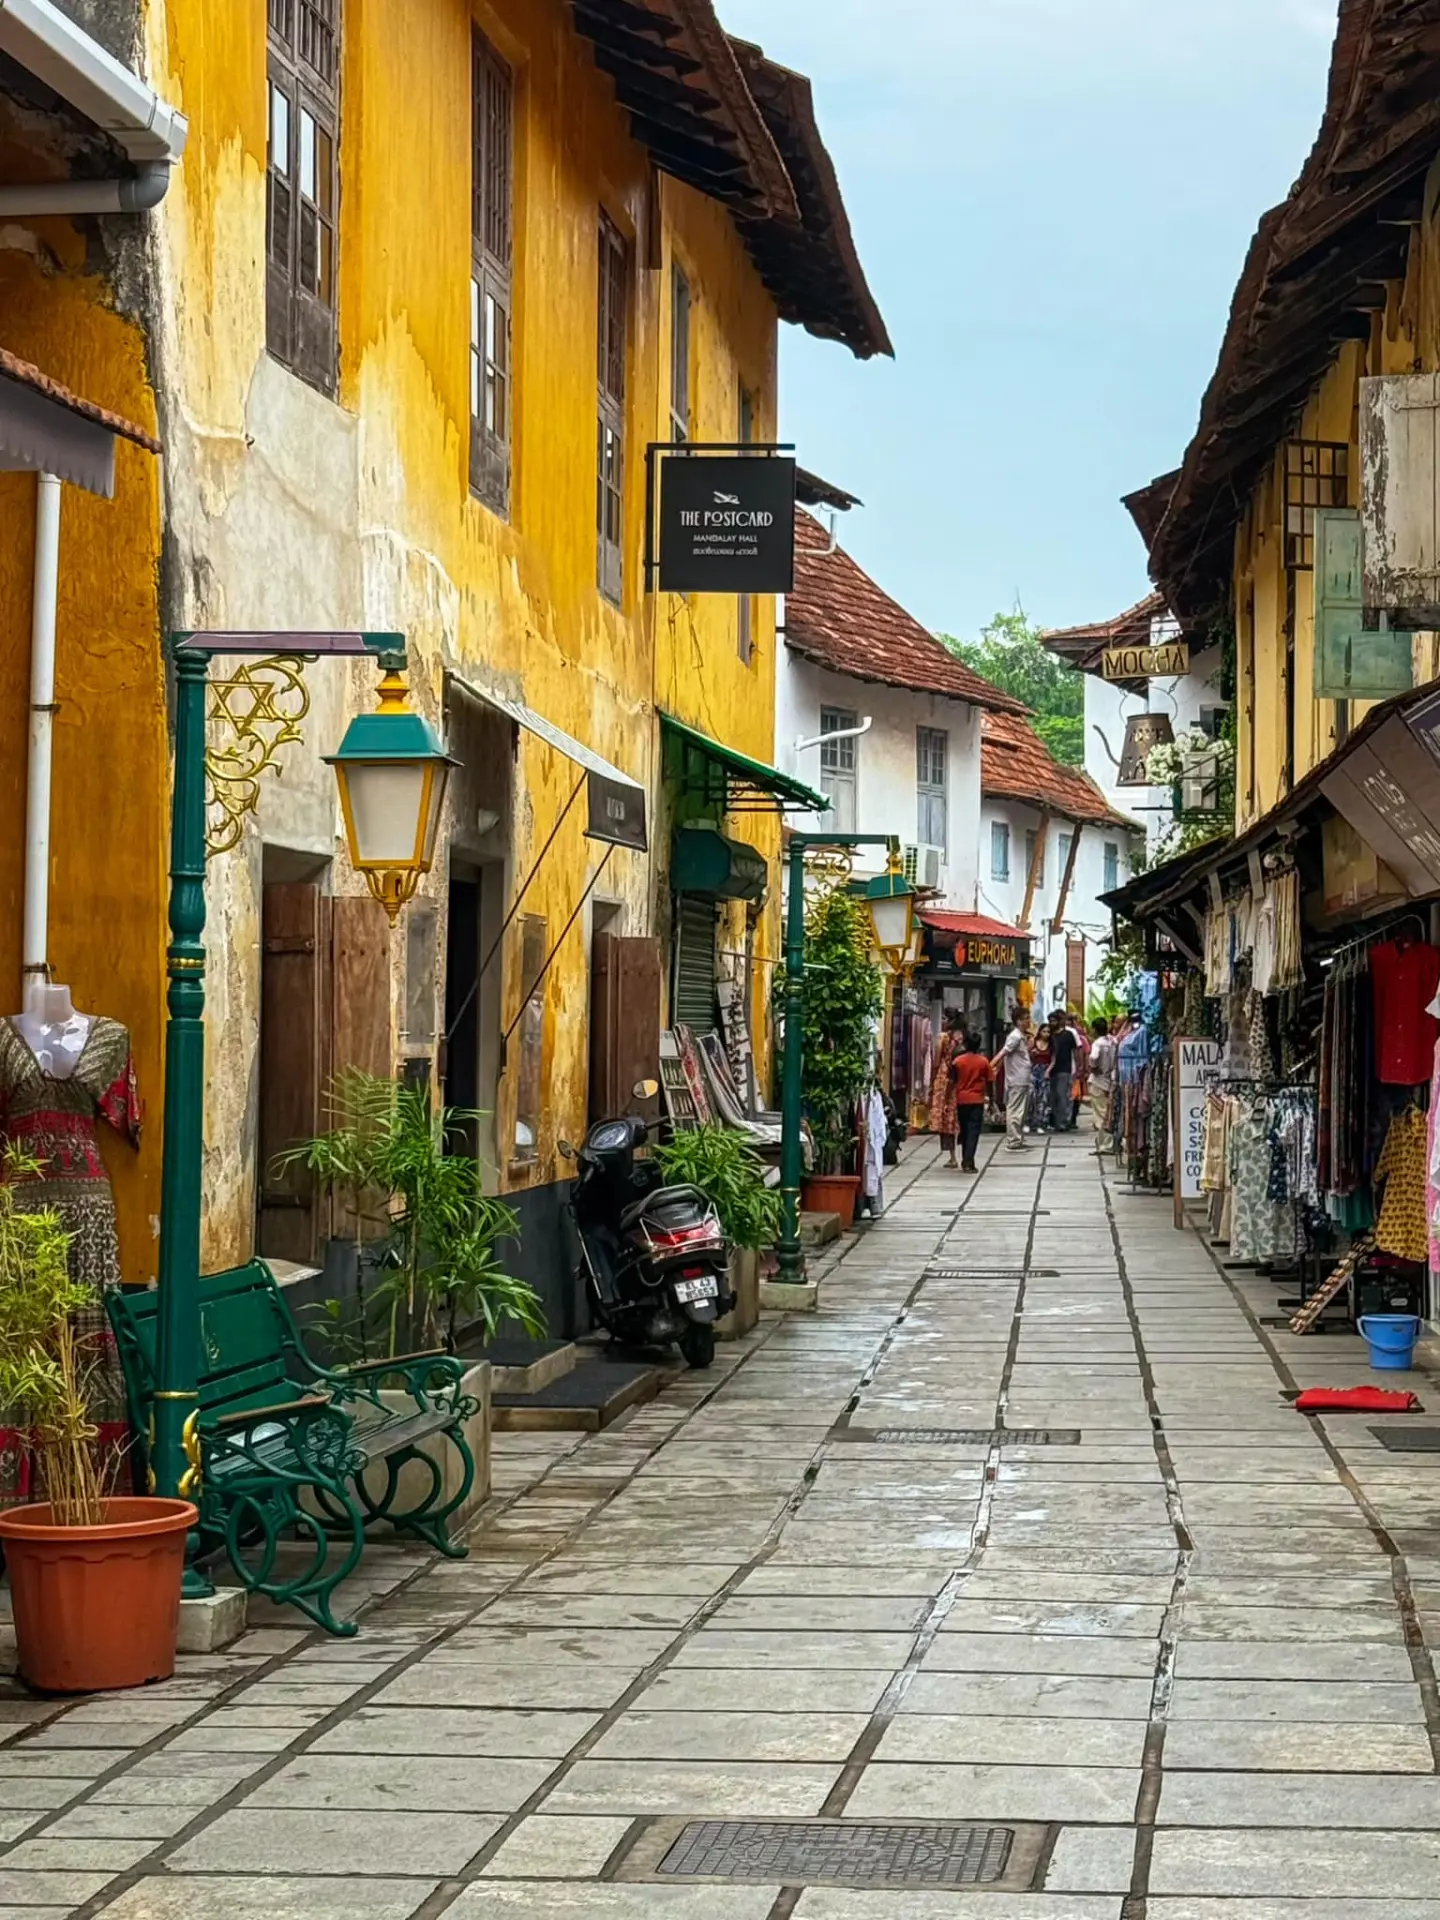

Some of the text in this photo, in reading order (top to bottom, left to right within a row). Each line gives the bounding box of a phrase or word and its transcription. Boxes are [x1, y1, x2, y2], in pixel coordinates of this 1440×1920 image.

[680, 511, 773, 527] THE POSTCARD
[693, 534, 758, 543] MANDALAY HALL
[1105, 647, 1185, 676] MOCHA
[968, 941, 1017, 965] EUPHORIA
